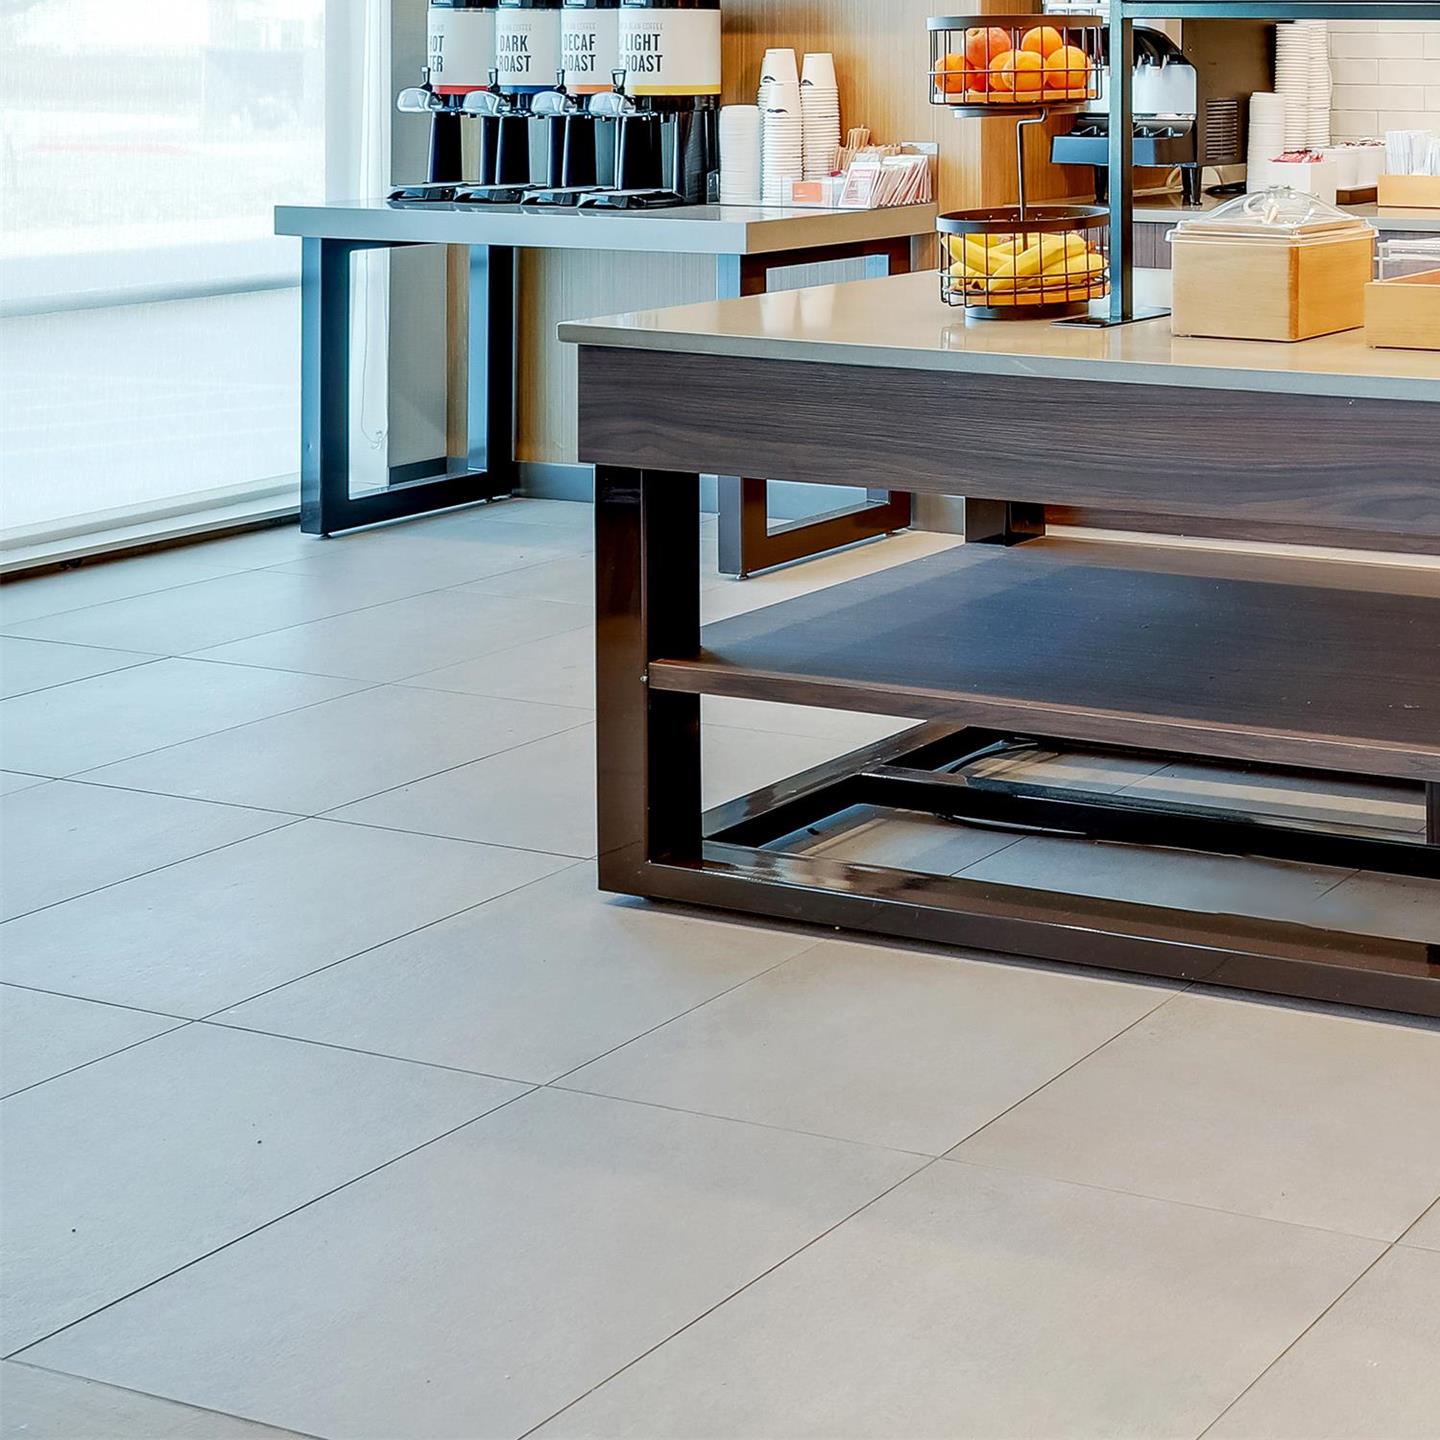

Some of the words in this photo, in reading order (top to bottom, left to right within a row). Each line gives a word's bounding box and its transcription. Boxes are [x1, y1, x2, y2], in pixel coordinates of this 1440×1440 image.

[430, 35, 444, 53] OT
[500, 34, 529, 53] DARK
[563, 33, 597, 52] DECAF
[625, 33, 661, 52] LIGHT
[498, 55, 532, 73] ROAST
[625, 54, 664, 73] ROAST
